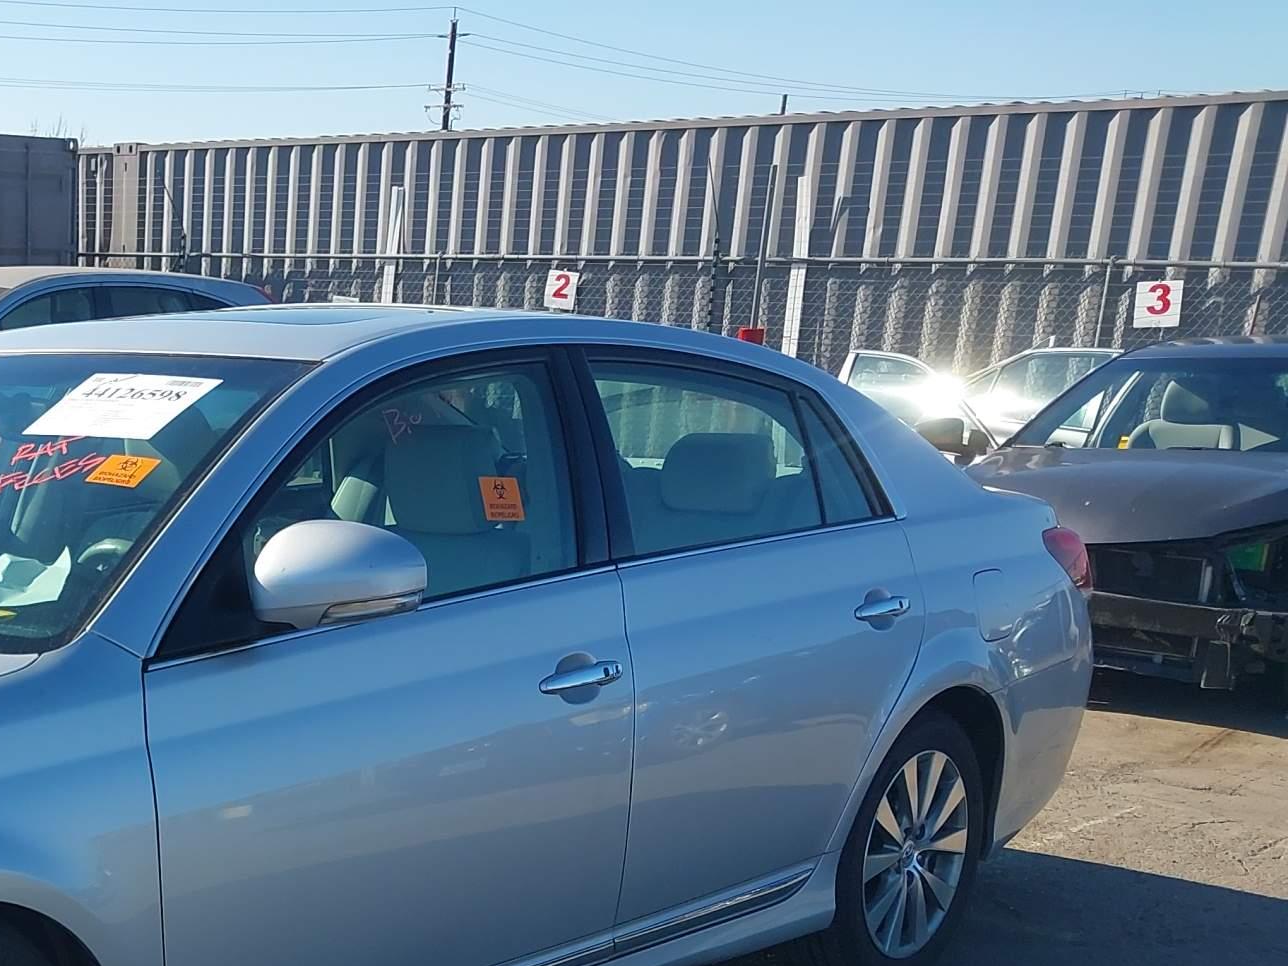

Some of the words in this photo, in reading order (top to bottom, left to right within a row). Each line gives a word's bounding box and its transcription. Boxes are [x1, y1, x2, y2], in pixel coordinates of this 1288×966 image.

[552, 274, 570, 299] 2
[1146, 283, 1171, 315] 3
[82, 386, 188, 402] 44126598
[11, 434, 88, 466] RAT
